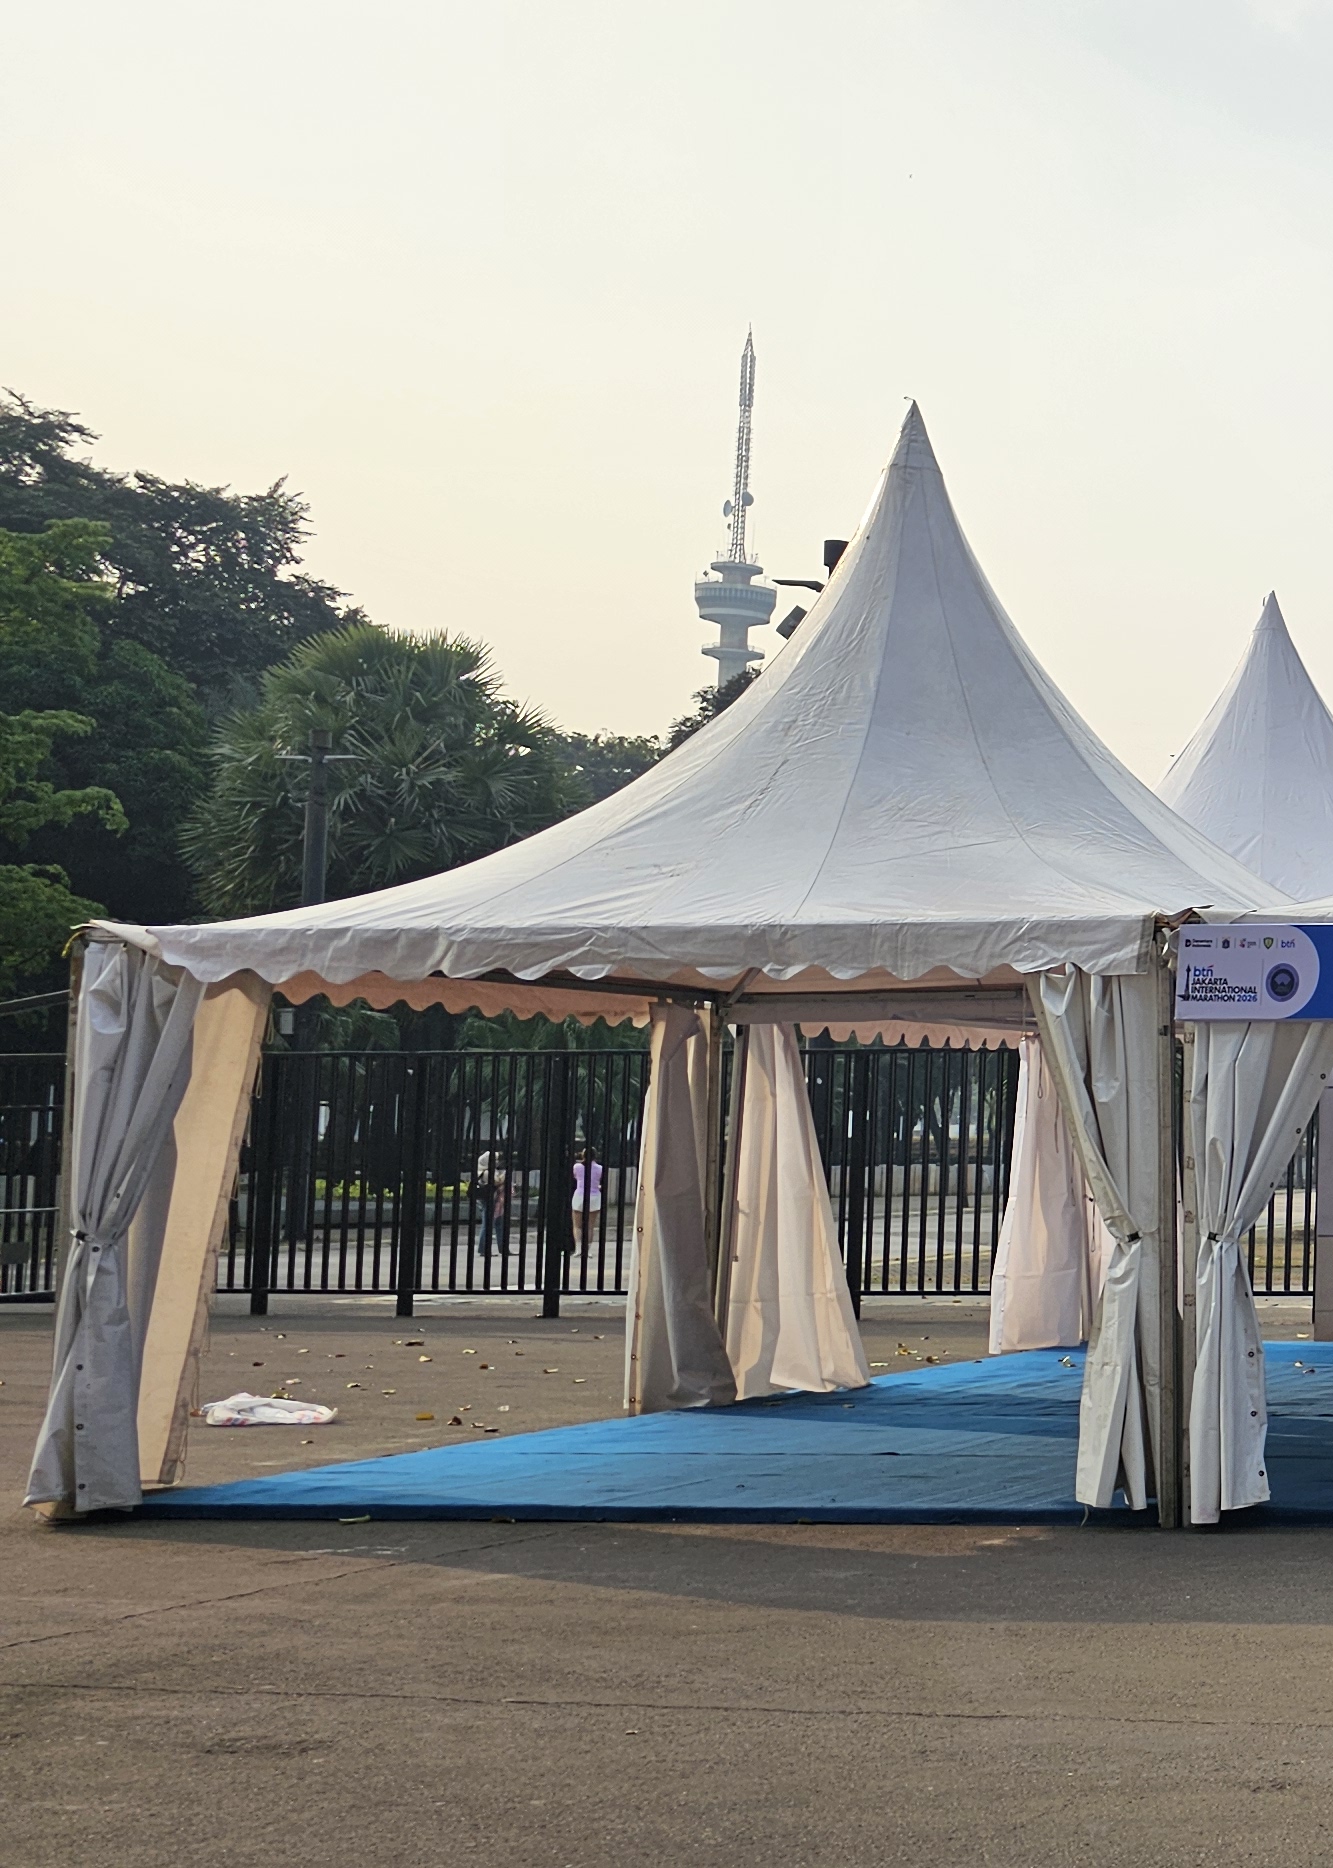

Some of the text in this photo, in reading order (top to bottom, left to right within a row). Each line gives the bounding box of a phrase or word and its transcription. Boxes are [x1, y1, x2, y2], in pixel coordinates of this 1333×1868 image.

[1193, 964, 1214, 977] btn
[1191, 978, 1228, 986] JAKARTA
[1191, 986, 1258, 994] INTERNATIONAL
[1191, 994, 1258, 1002] MARATHON 2026
